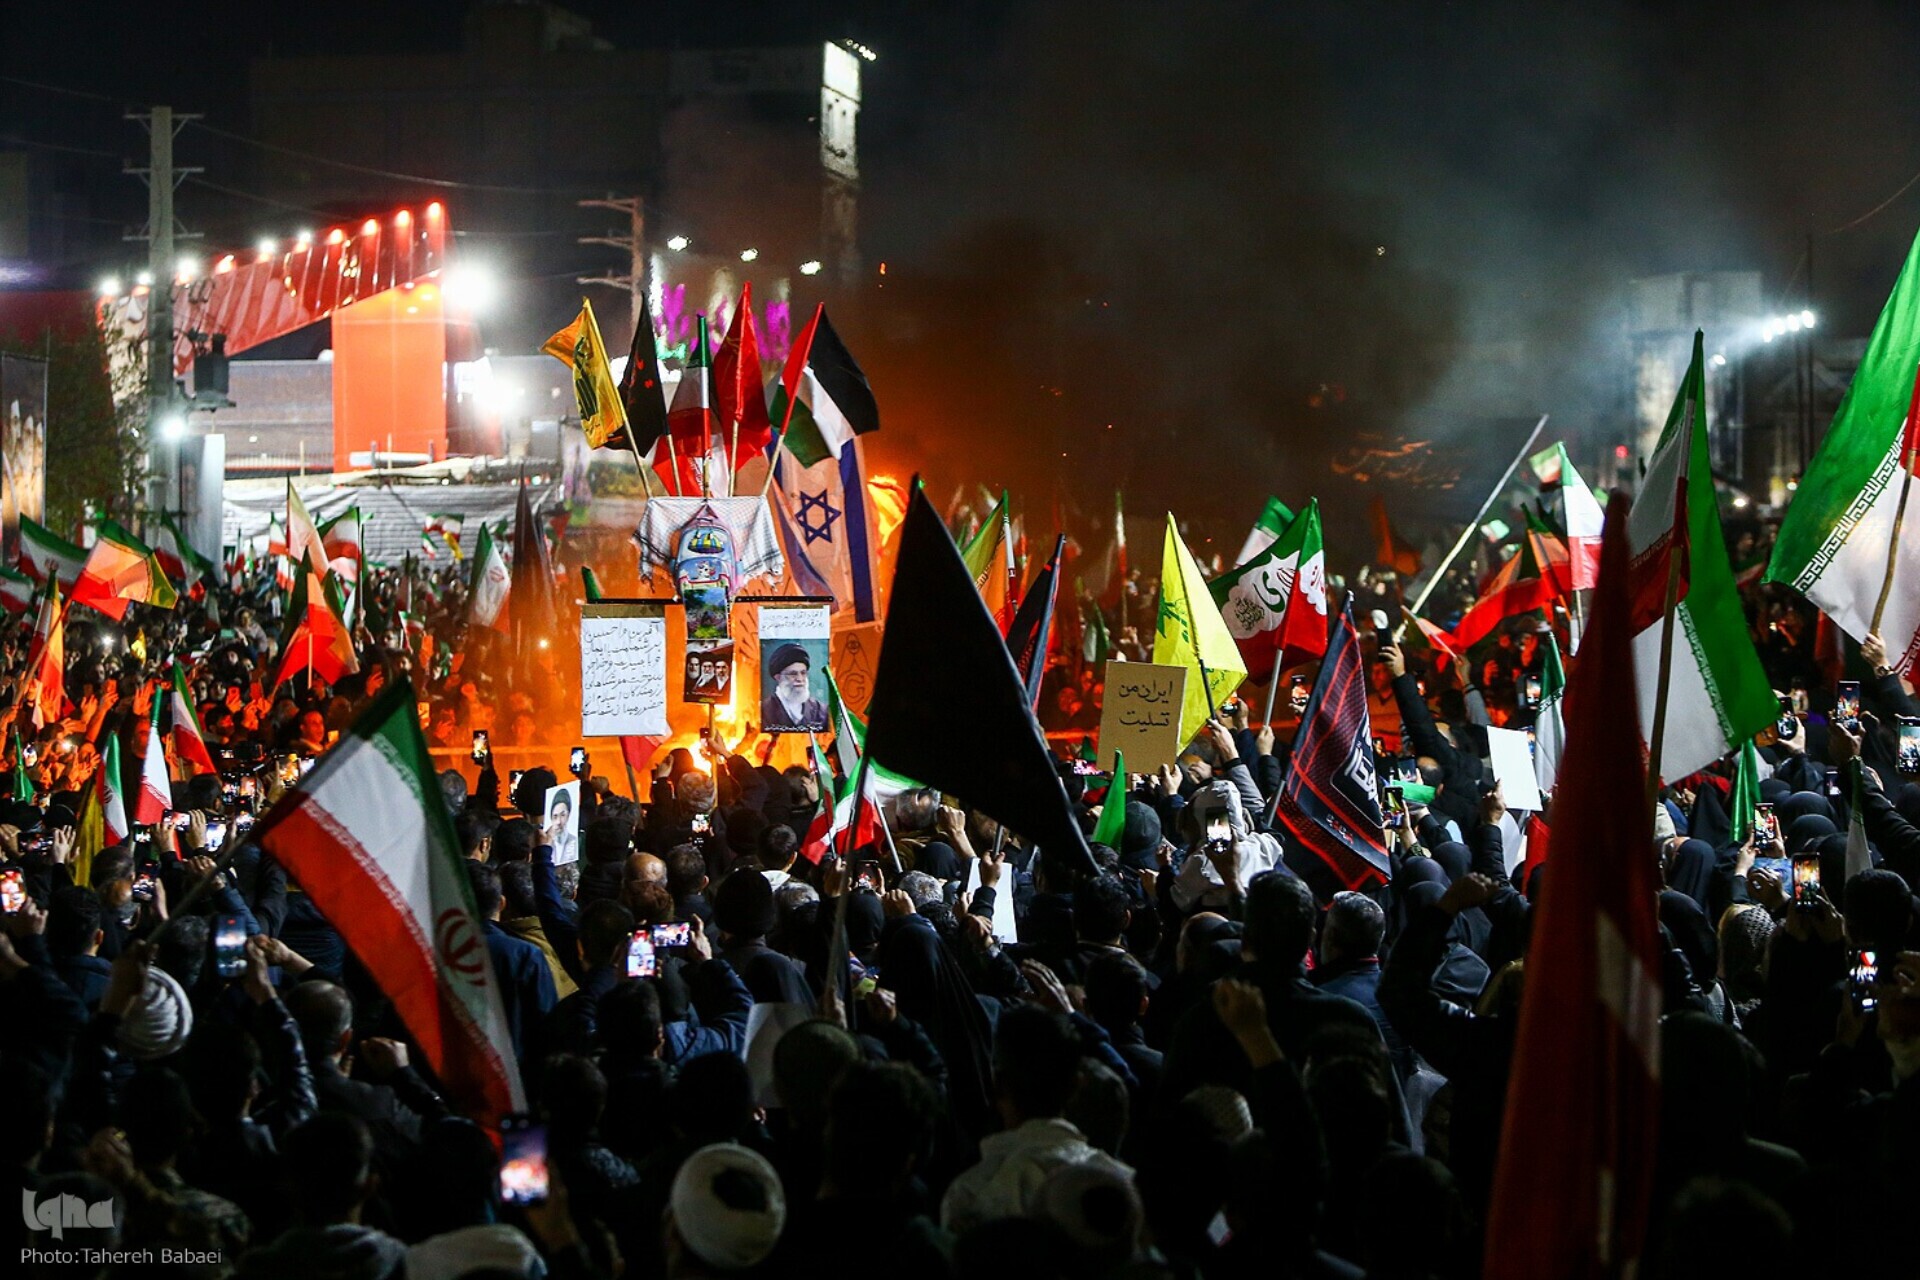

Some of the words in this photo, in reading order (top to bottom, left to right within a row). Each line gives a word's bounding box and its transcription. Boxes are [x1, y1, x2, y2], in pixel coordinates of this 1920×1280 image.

[1118, 684, 1139, 698] من
[1137, 680, 1173, 703] ایران
[1118, 710, 1171, 733] تسلیت
